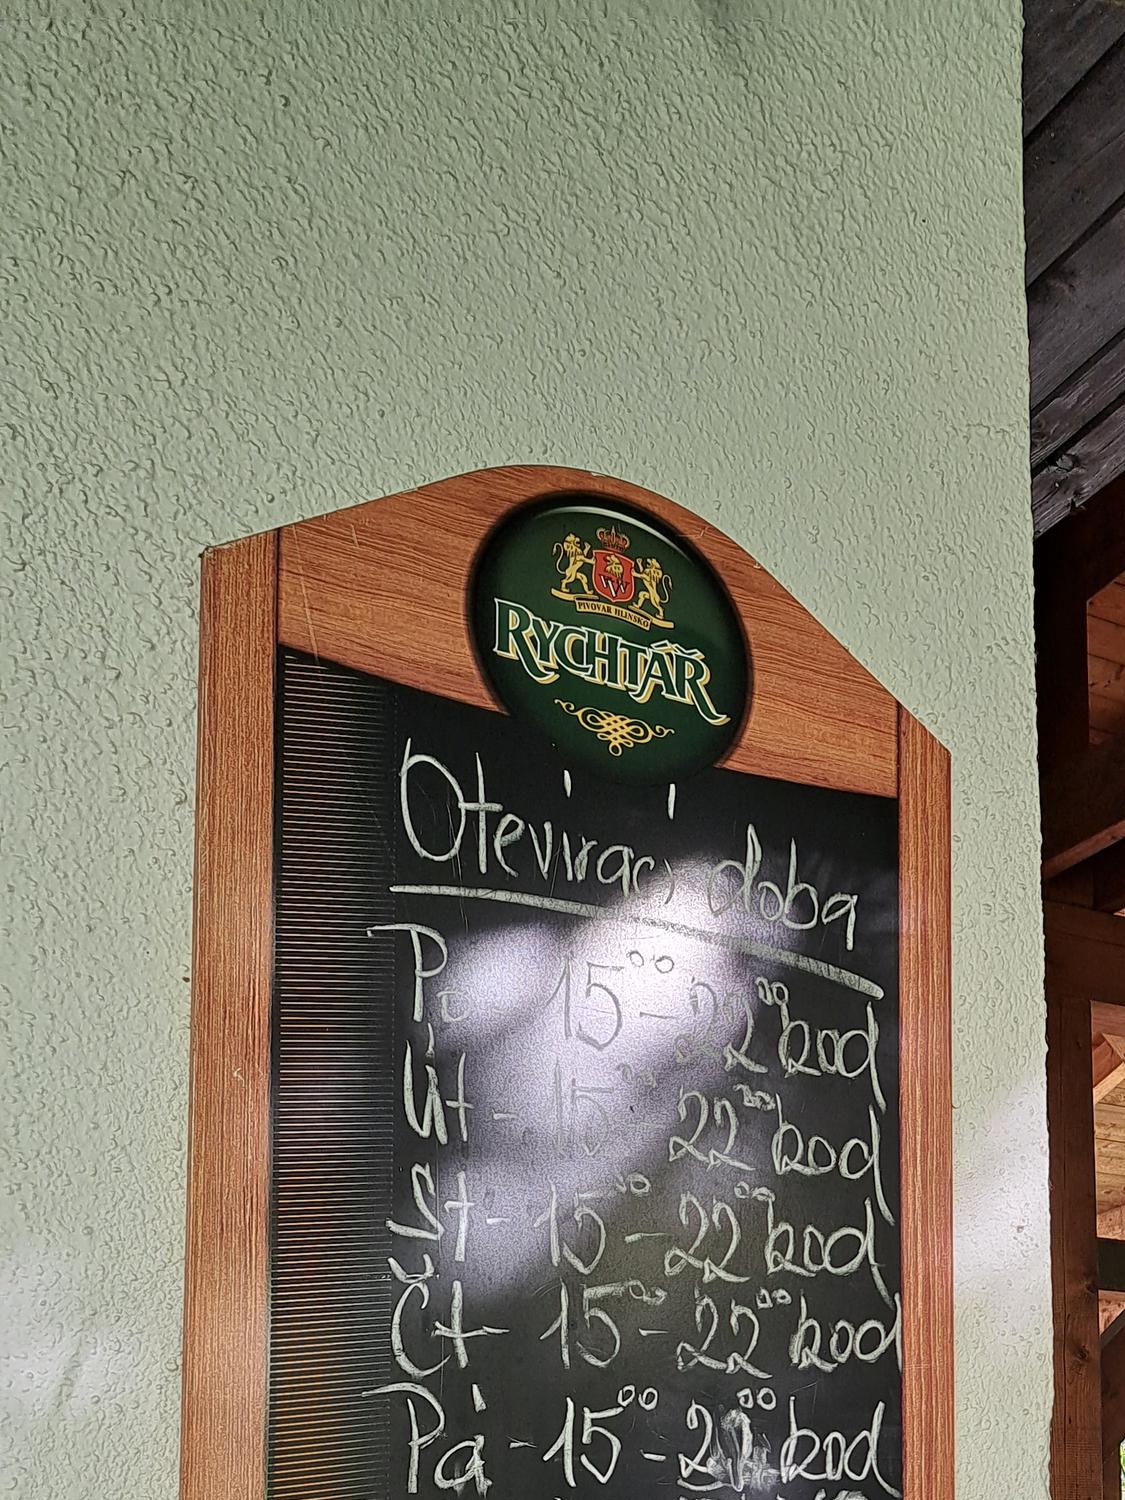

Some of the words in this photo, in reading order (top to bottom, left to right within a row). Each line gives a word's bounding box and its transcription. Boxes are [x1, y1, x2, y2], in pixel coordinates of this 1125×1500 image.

[493, 597, 731, 726] RYCHTÁŘ
[577, 601, 613, 614] PIVOVAR
[614, 607, 649, 628] HLINSKO
[707, 823, 861, 952] doba
